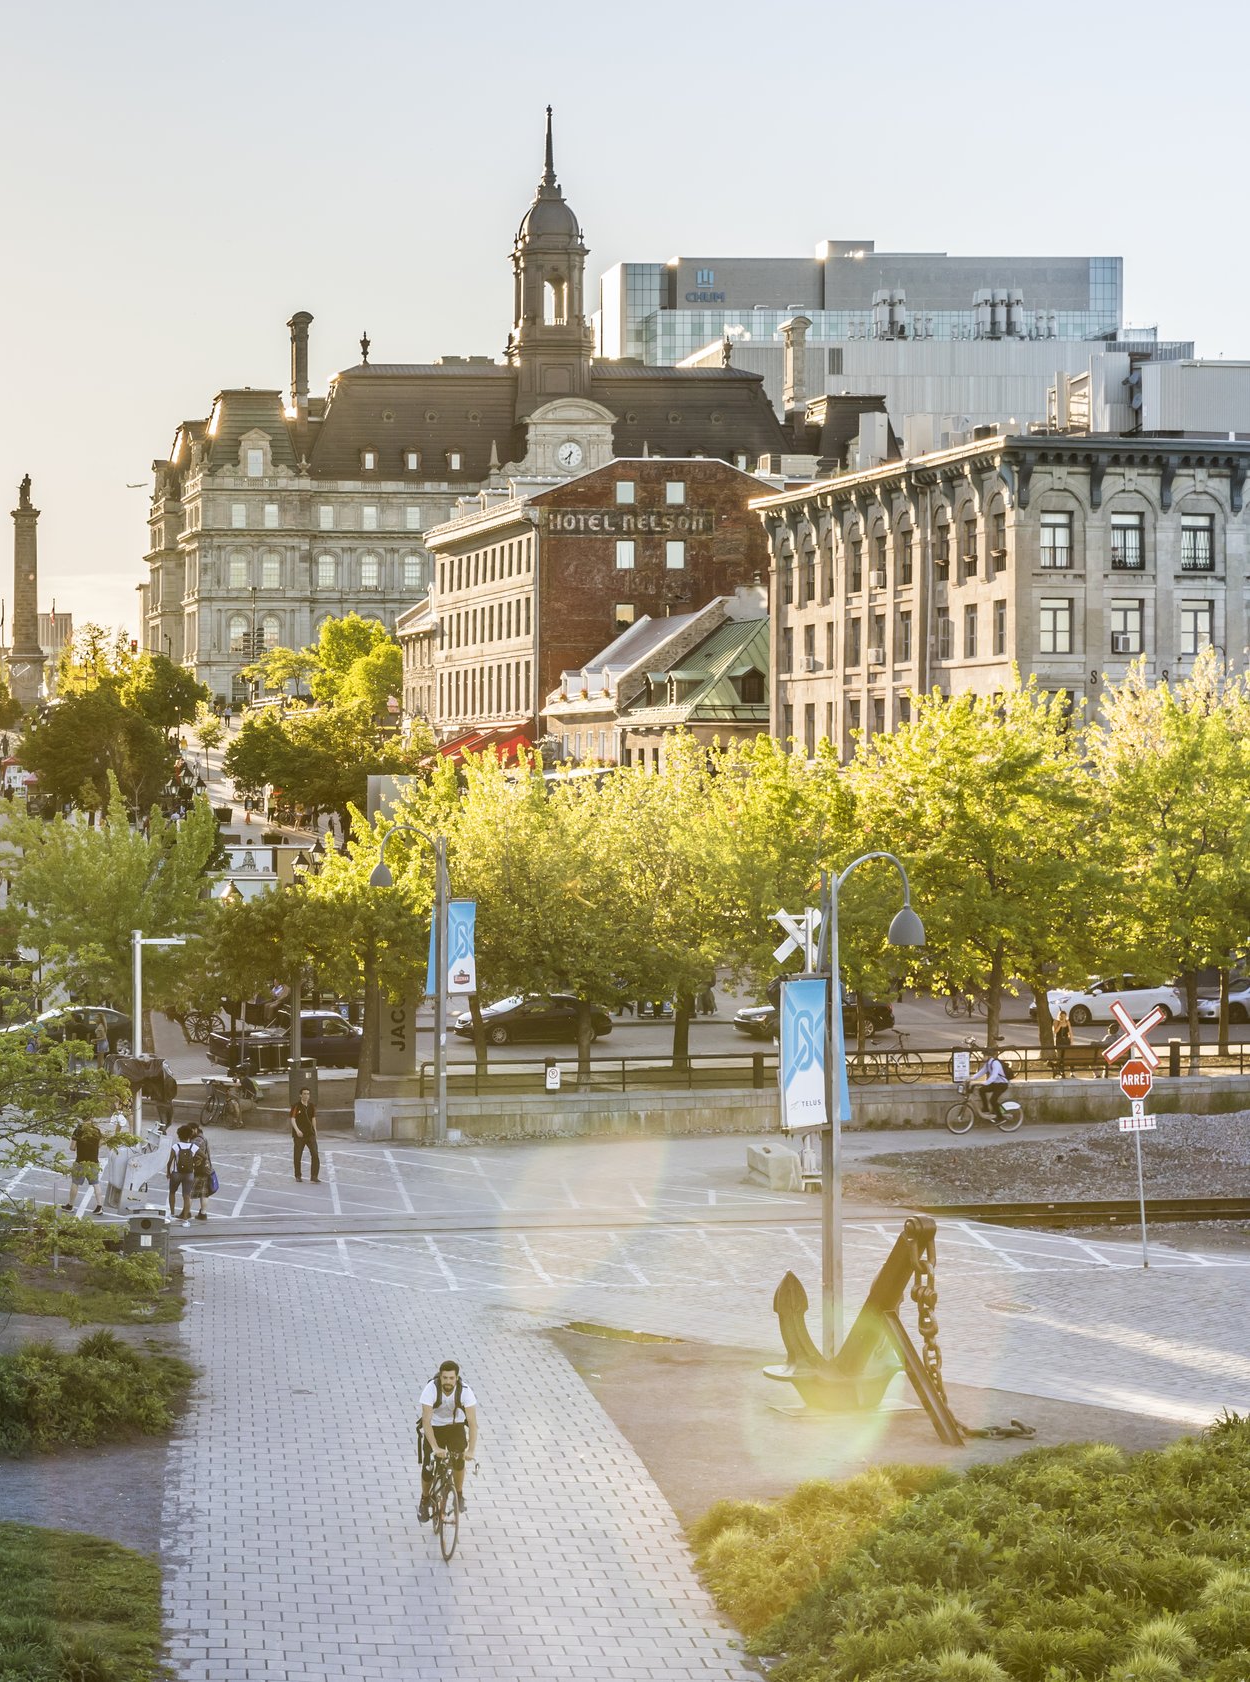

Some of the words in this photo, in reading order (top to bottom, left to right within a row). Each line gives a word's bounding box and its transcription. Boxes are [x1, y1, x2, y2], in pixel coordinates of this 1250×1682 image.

[686, 292, 725, 302] CHUM
[549, 513, 616, 531] HOTEL
[1122, 1072, 1151, 1086] ARRÊT
[802, 1099, 822, 1107] TELUS
[1135, 1103, 1141, 1114] 2
